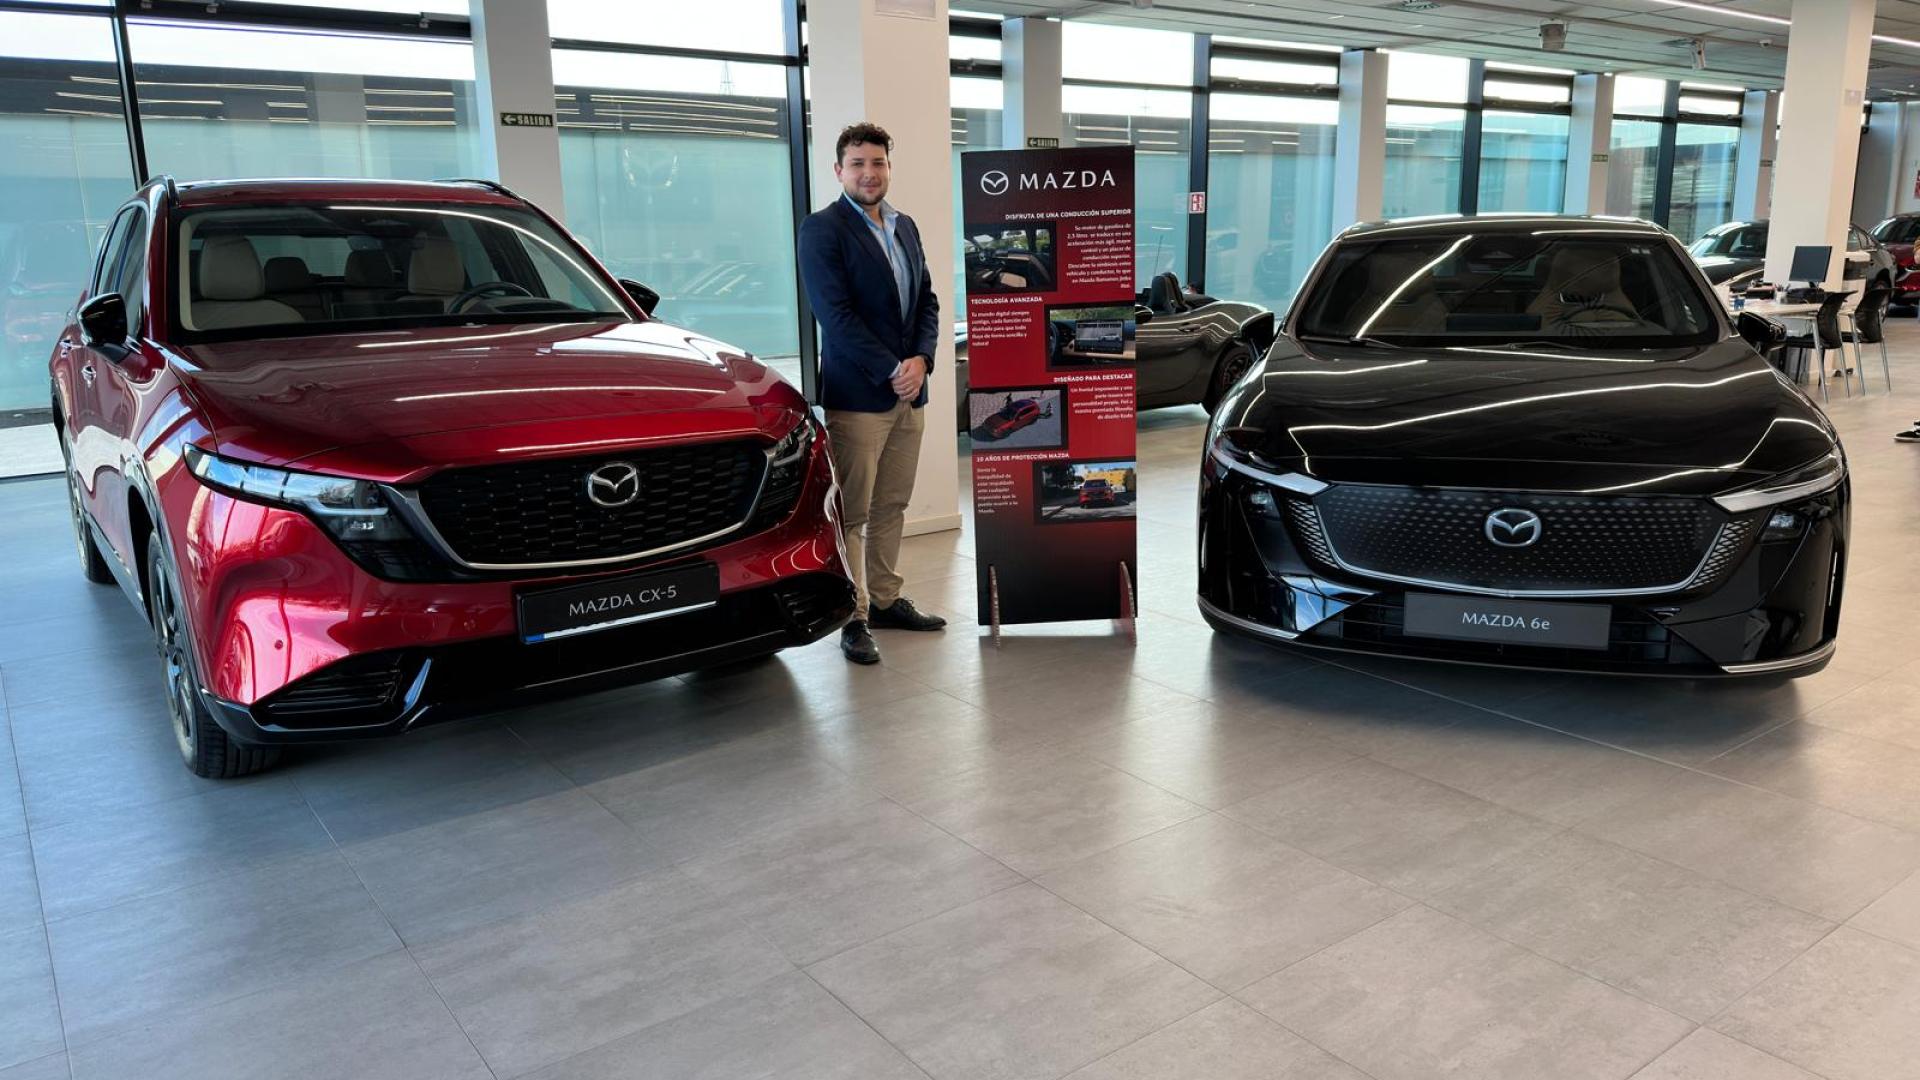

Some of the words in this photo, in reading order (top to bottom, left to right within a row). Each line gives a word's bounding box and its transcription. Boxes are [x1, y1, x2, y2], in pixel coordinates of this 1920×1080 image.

[517, 114, 551, 126] SALIDA
[1019, 170, 1116, 190] MAZDA
[1060, 209, 1100, 218] CONDUCCIÓN
[1101, 208, 1131, 217] SUPERIOR
[971, 296, 1008, 305] TECNOLOGÍA
[1009, 296, 1043, 304] AVANZADA
[1054, 375, 1084, 383] DISEÑADO
[1085, 374, 1101, 382] PARA
[984, 453, 1001, 462] AÑOS
[1002, 453, 1010, 461] DE
[1011, 452, 1047, 461] PROTECCIÓN
[569, 593, 634, 616] MAZDA
[639, 585, 677, 603] CX-5
[1462, 612, 1525, 629] MAZDA
[1530, 617, 1550, 630] 6e
